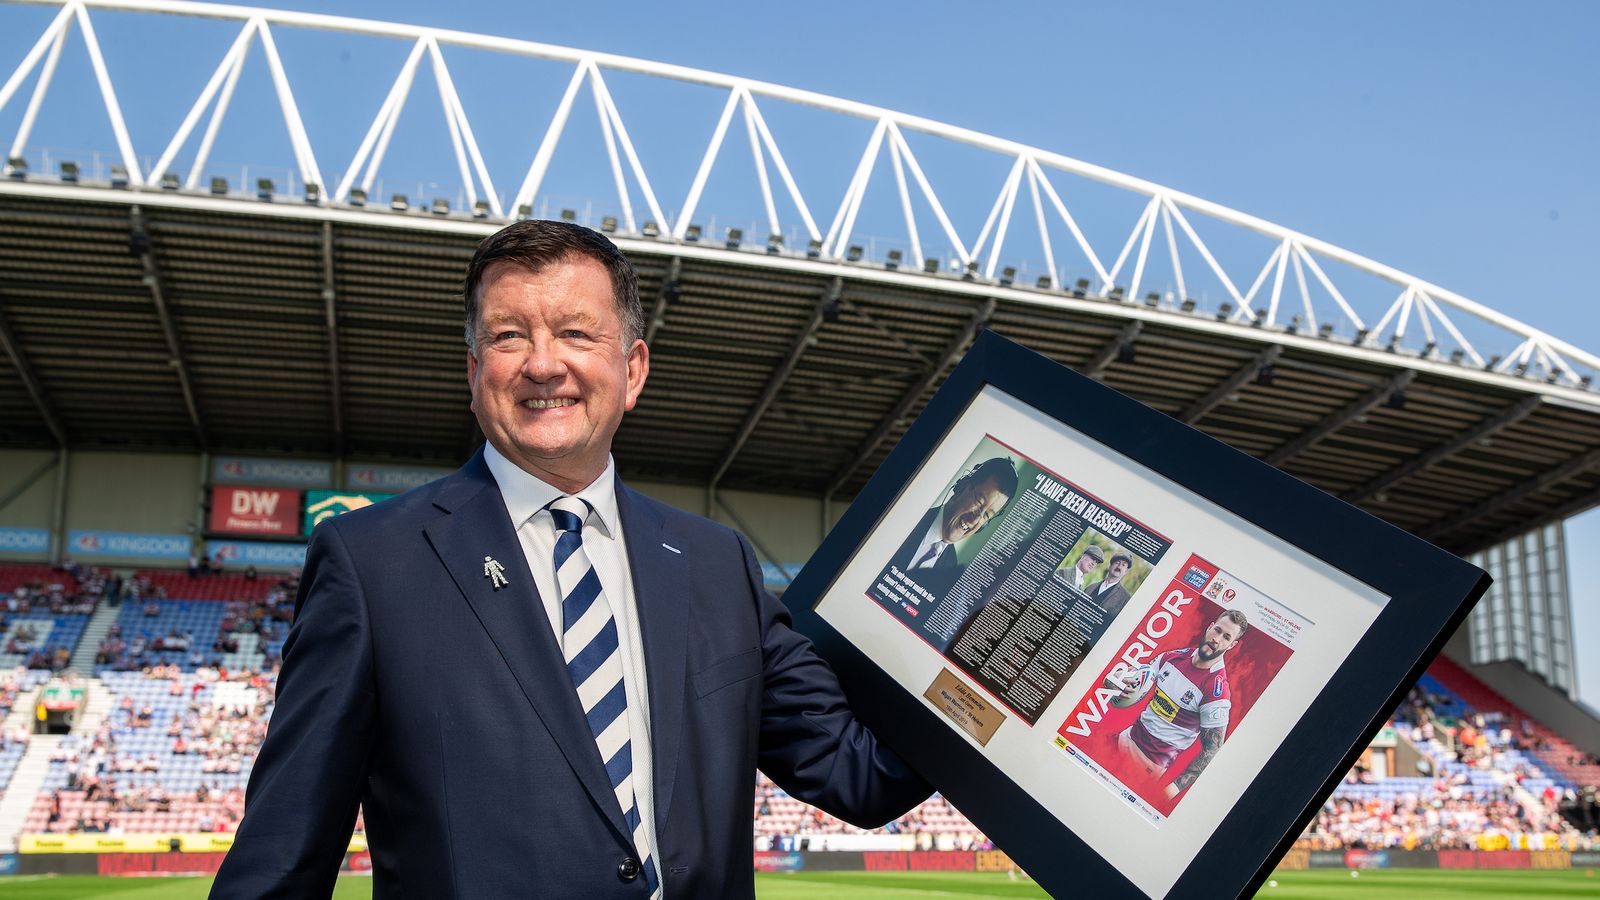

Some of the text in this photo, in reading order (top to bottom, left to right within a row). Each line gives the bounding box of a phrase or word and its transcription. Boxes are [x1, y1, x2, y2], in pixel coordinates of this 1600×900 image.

[253, 463, 330, 480] KINGDOM
[232, 490, 280, 516] DW
[1039, 478, 1068, 502] HAVE
[1060, 490, 1090, 516] BEEN
[108, 536, 191, 554] KINGDOM
[1192, 574, 1206, 584] SUPER
[1066, 589, 1194, 738] WARRIOR
